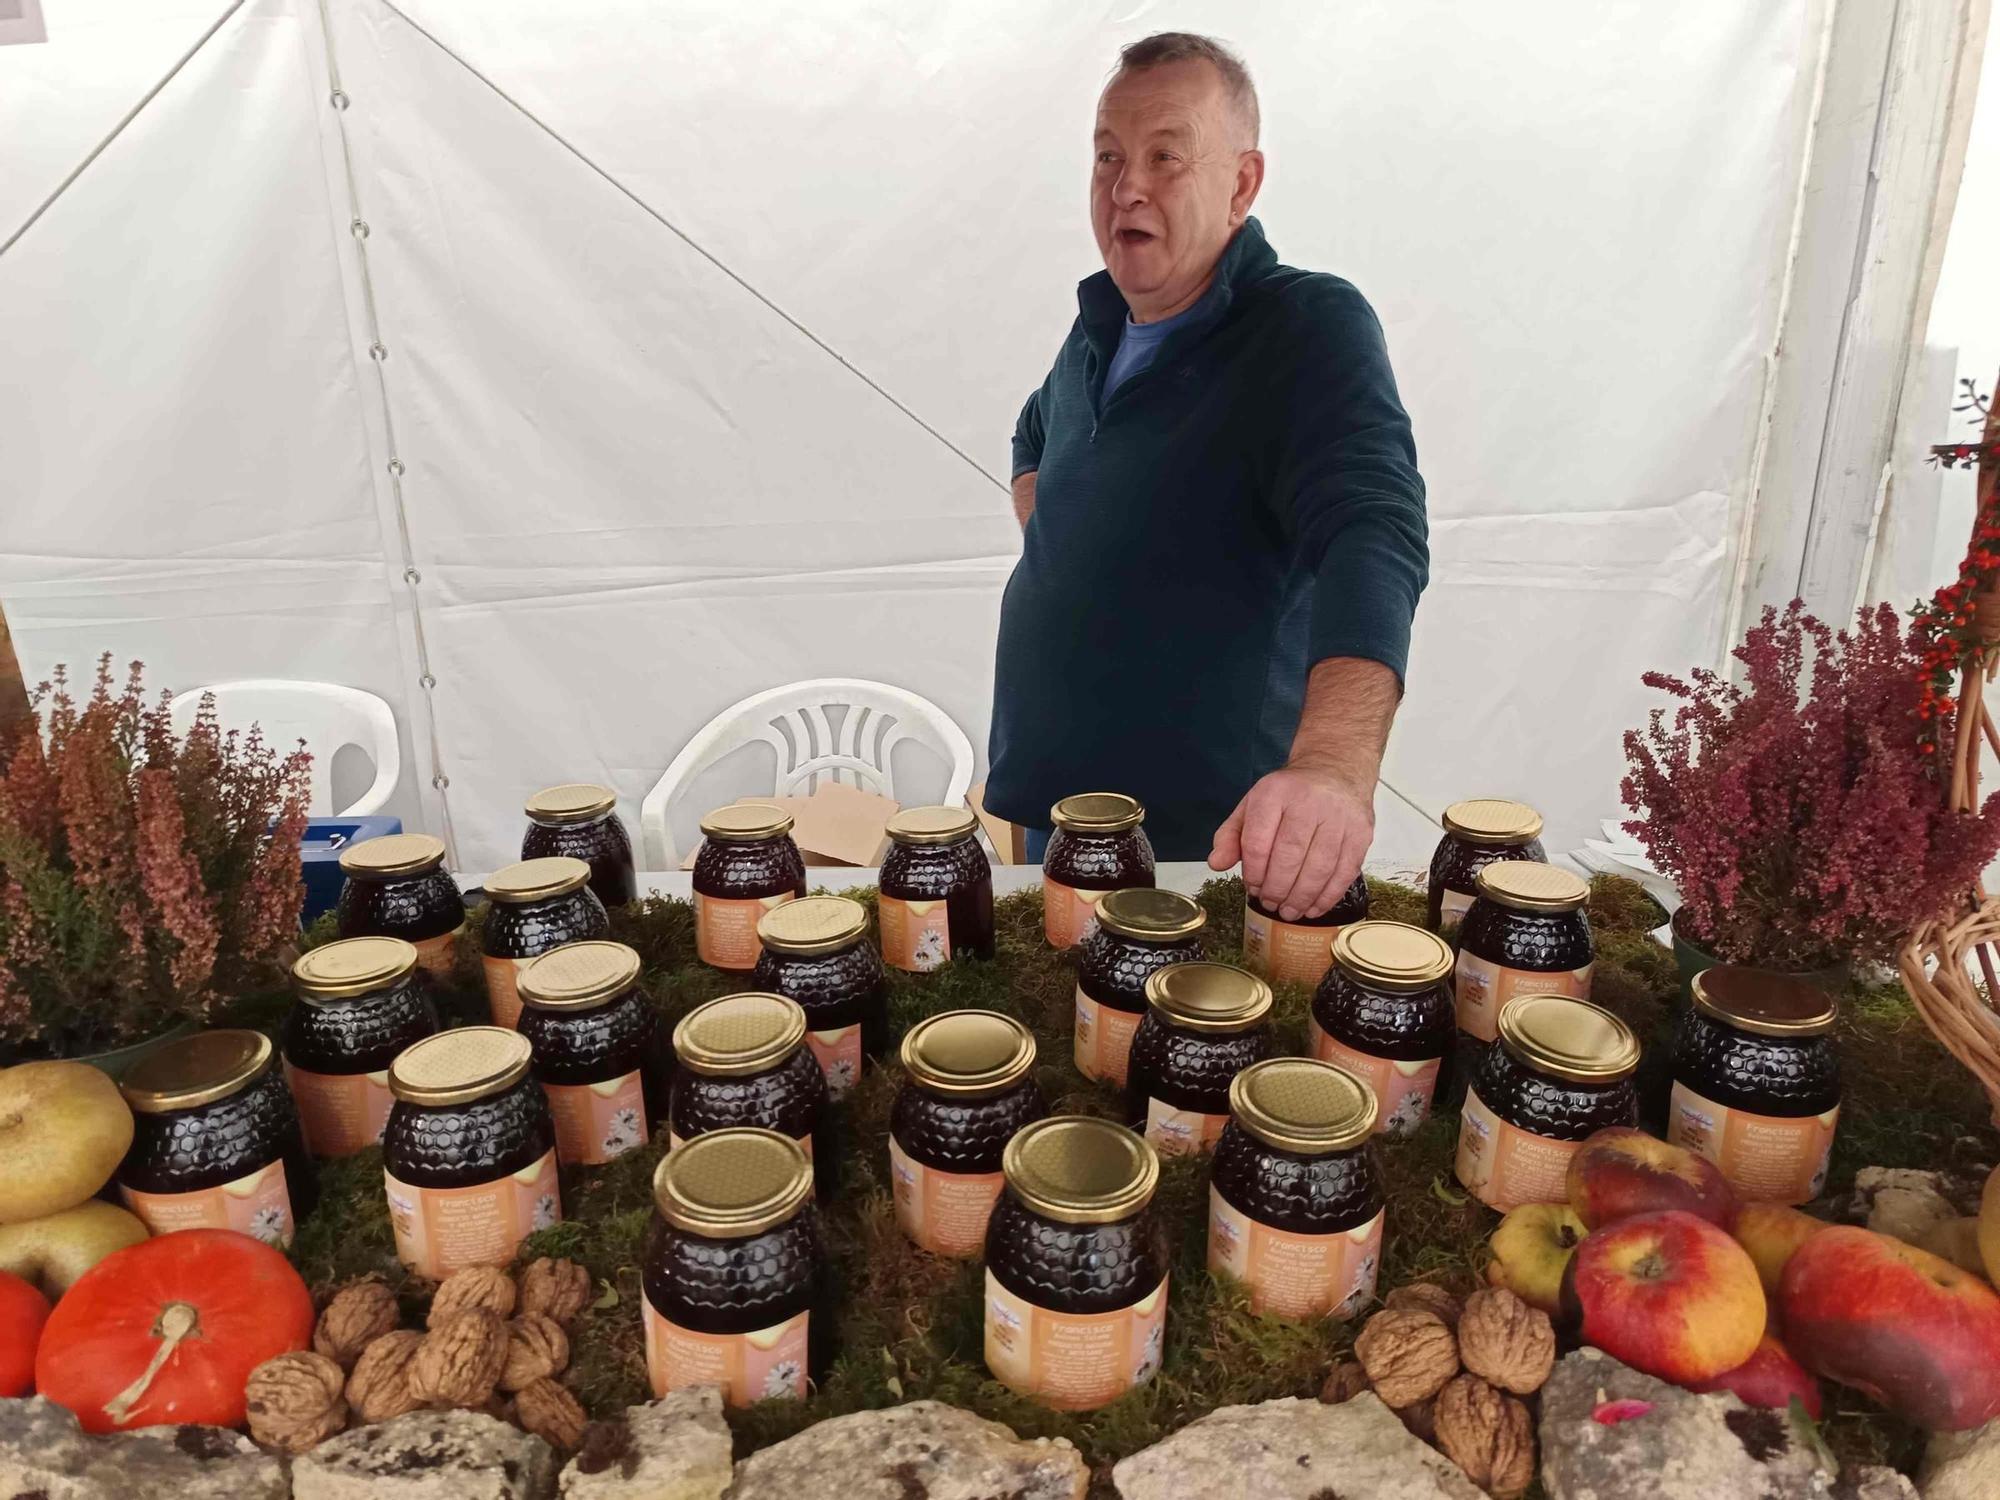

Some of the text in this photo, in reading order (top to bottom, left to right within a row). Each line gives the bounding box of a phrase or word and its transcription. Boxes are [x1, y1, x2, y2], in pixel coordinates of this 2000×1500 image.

[1284, 931, 1325, 943] Francisco
[1514, 978, 1559, 989] Francisco
[1331, 1047, 1375, 1072] Francisco
[1746, 1123, 1802, 1136] Francisco
[1515, 1137, 1573, 1159] Francisco
[439, 1193, 497, 1208] Francisco
[1268, 1236, 1328, 1254] Francisco
[1051, 1321, 1114, 1335] Francisco
